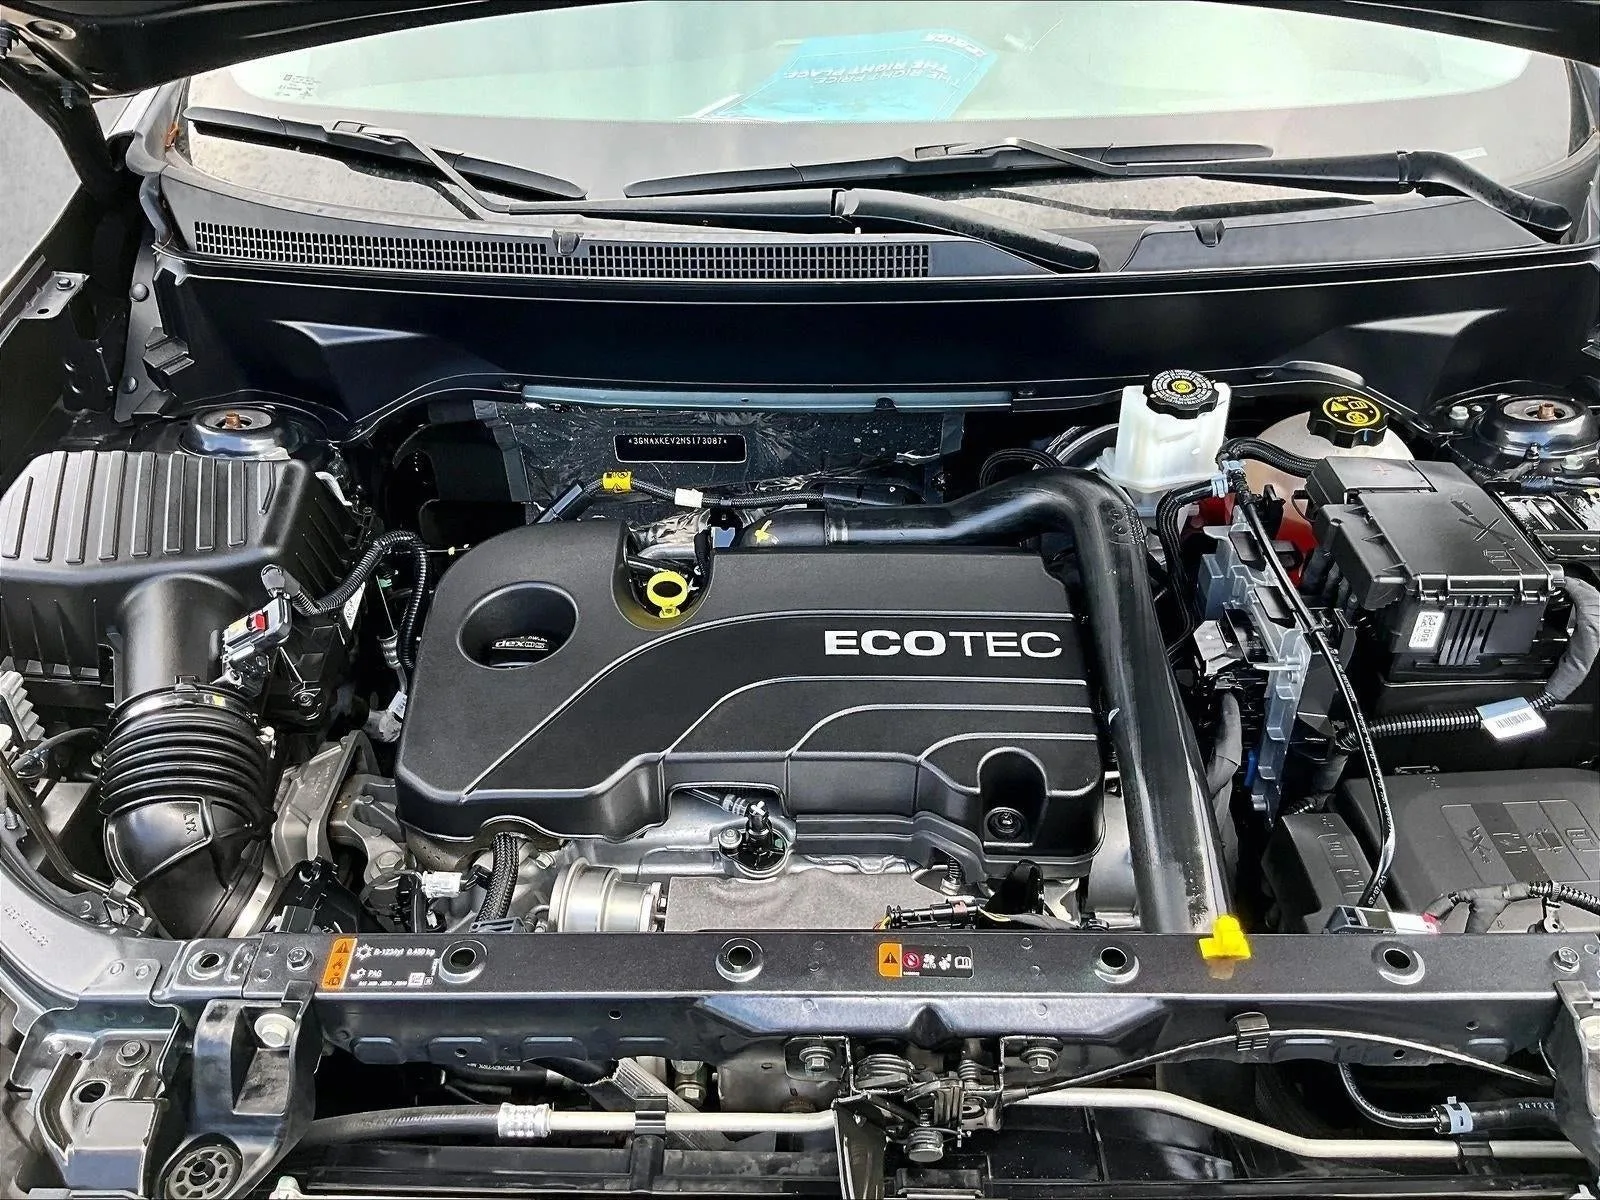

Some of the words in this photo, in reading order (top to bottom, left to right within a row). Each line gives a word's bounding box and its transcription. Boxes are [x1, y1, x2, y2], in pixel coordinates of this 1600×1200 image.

[495, 640, 545, 649] dexos
[824, 630, 1062, 658] ECOTEC
[368, 969, 382, 977] PAG
